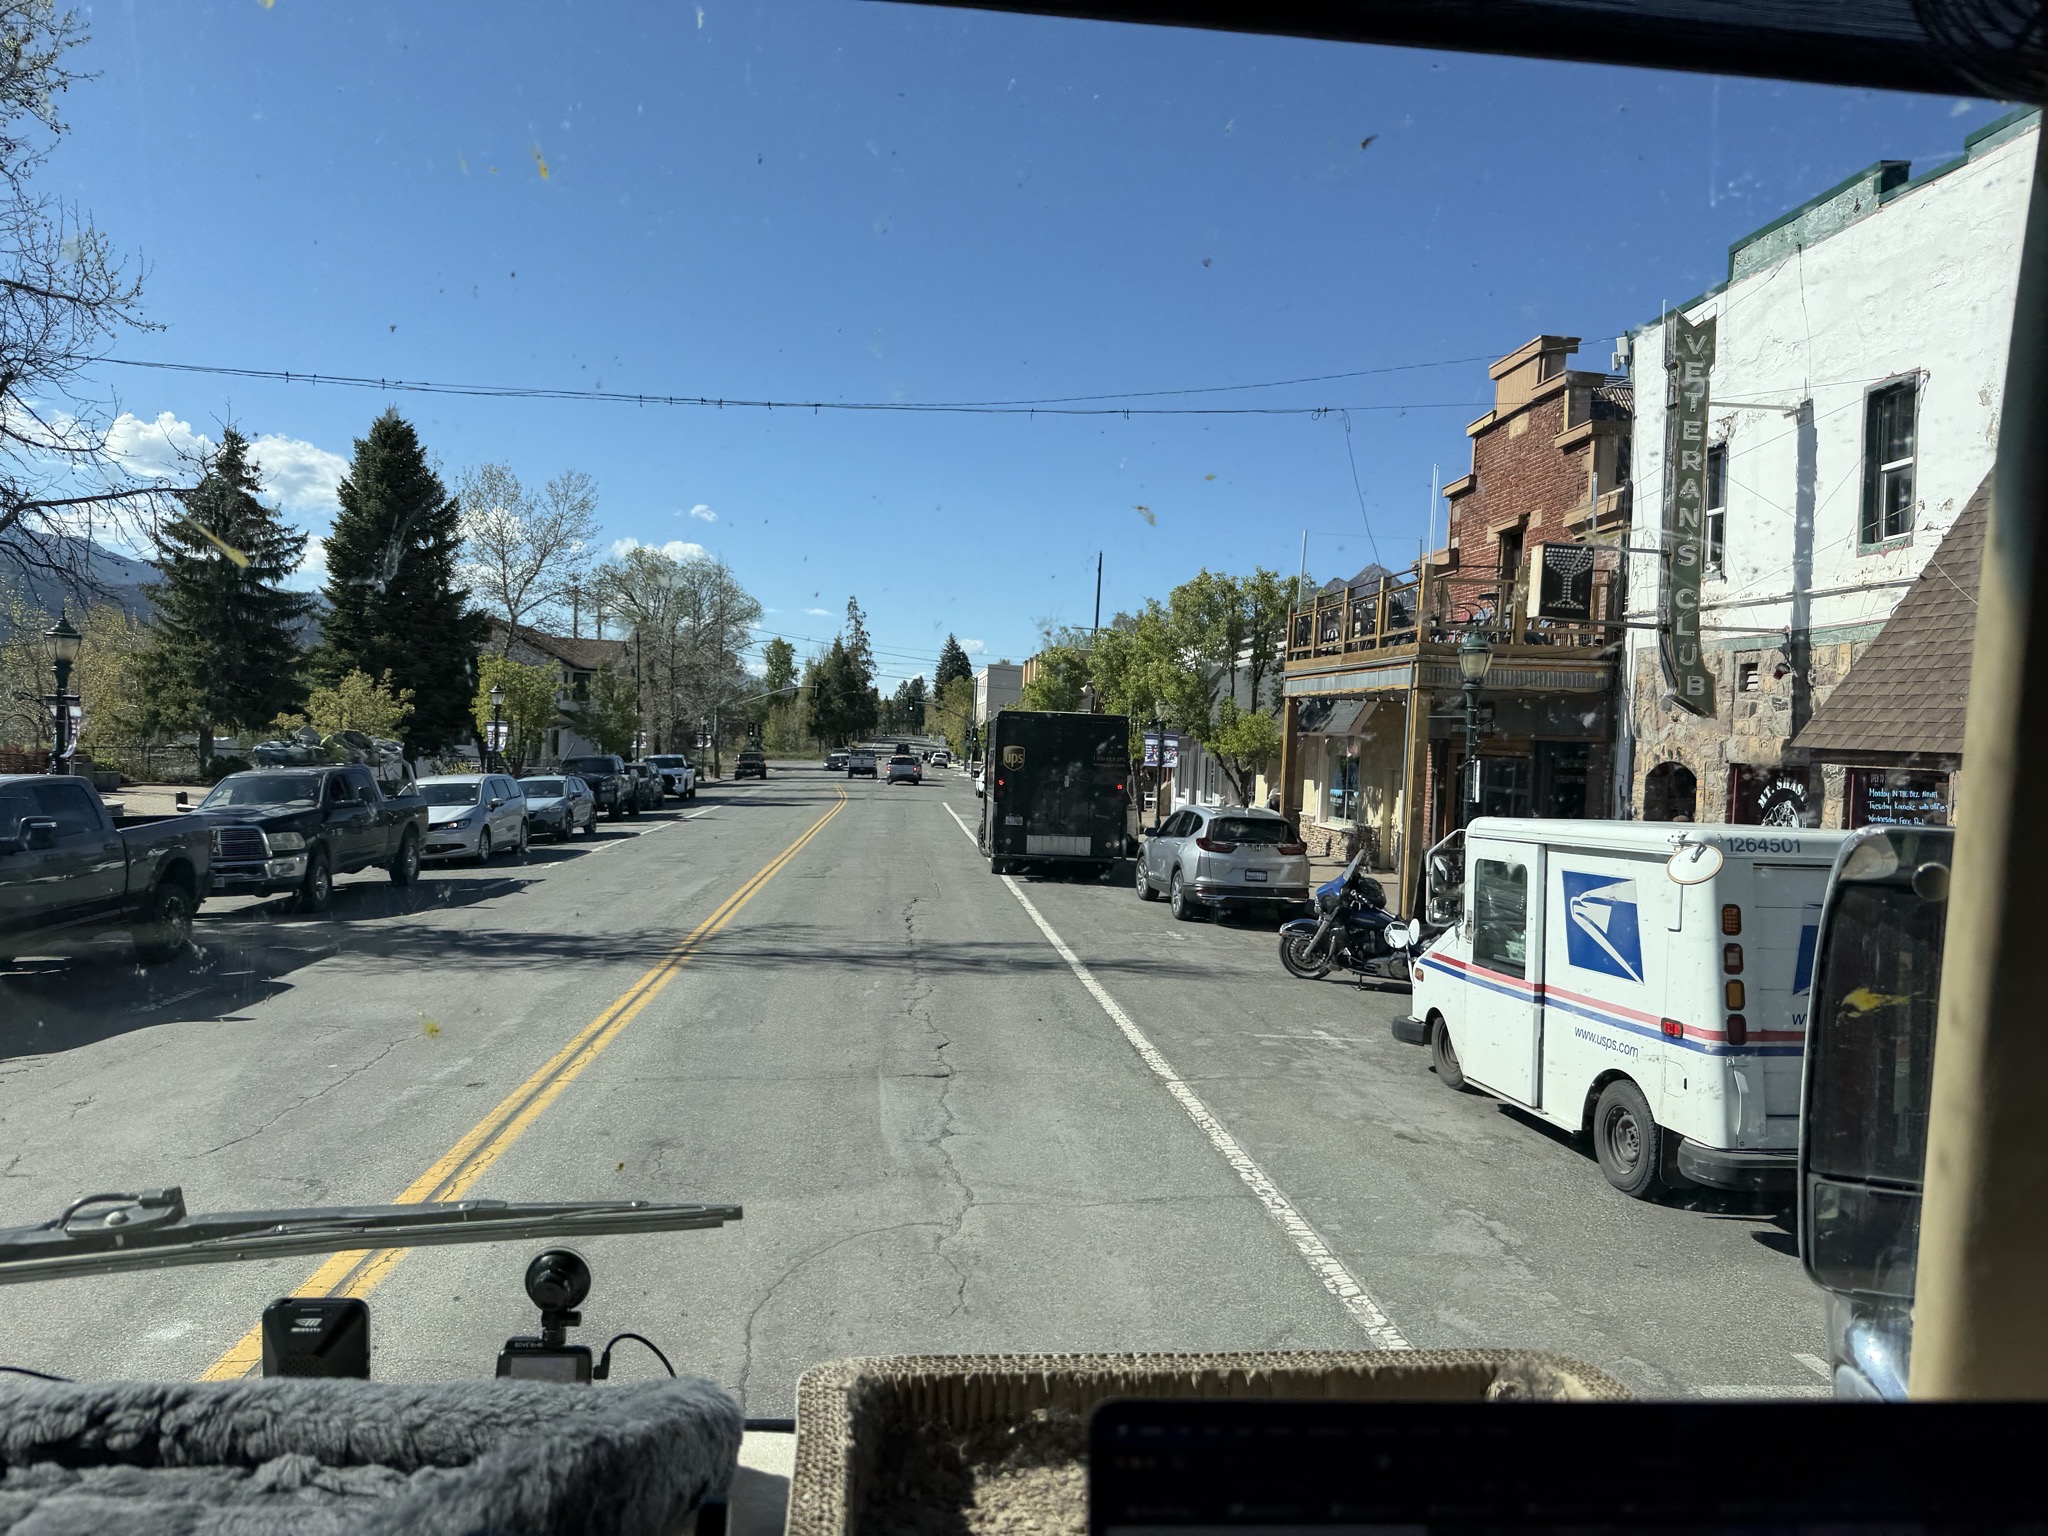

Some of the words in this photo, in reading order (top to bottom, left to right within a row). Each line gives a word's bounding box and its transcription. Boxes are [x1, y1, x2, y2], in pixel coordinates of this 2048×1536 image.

[1678, 334, 1708, 566] VETERANS
[1675, 588, 1705, 696] CLUB
[1005, 753, 1024, 767] ups
[1757, 785, 1775, 809] MT.
[1868, 787, 1890, 804] Monday
[1867, 800, 1892, 817] Tuesday
[1868, 814, 1897, 825] Wednesday
[1726, 837, 1801, 853] 1264501
[1574, 1026, 1639, 1058] www.usps.com
